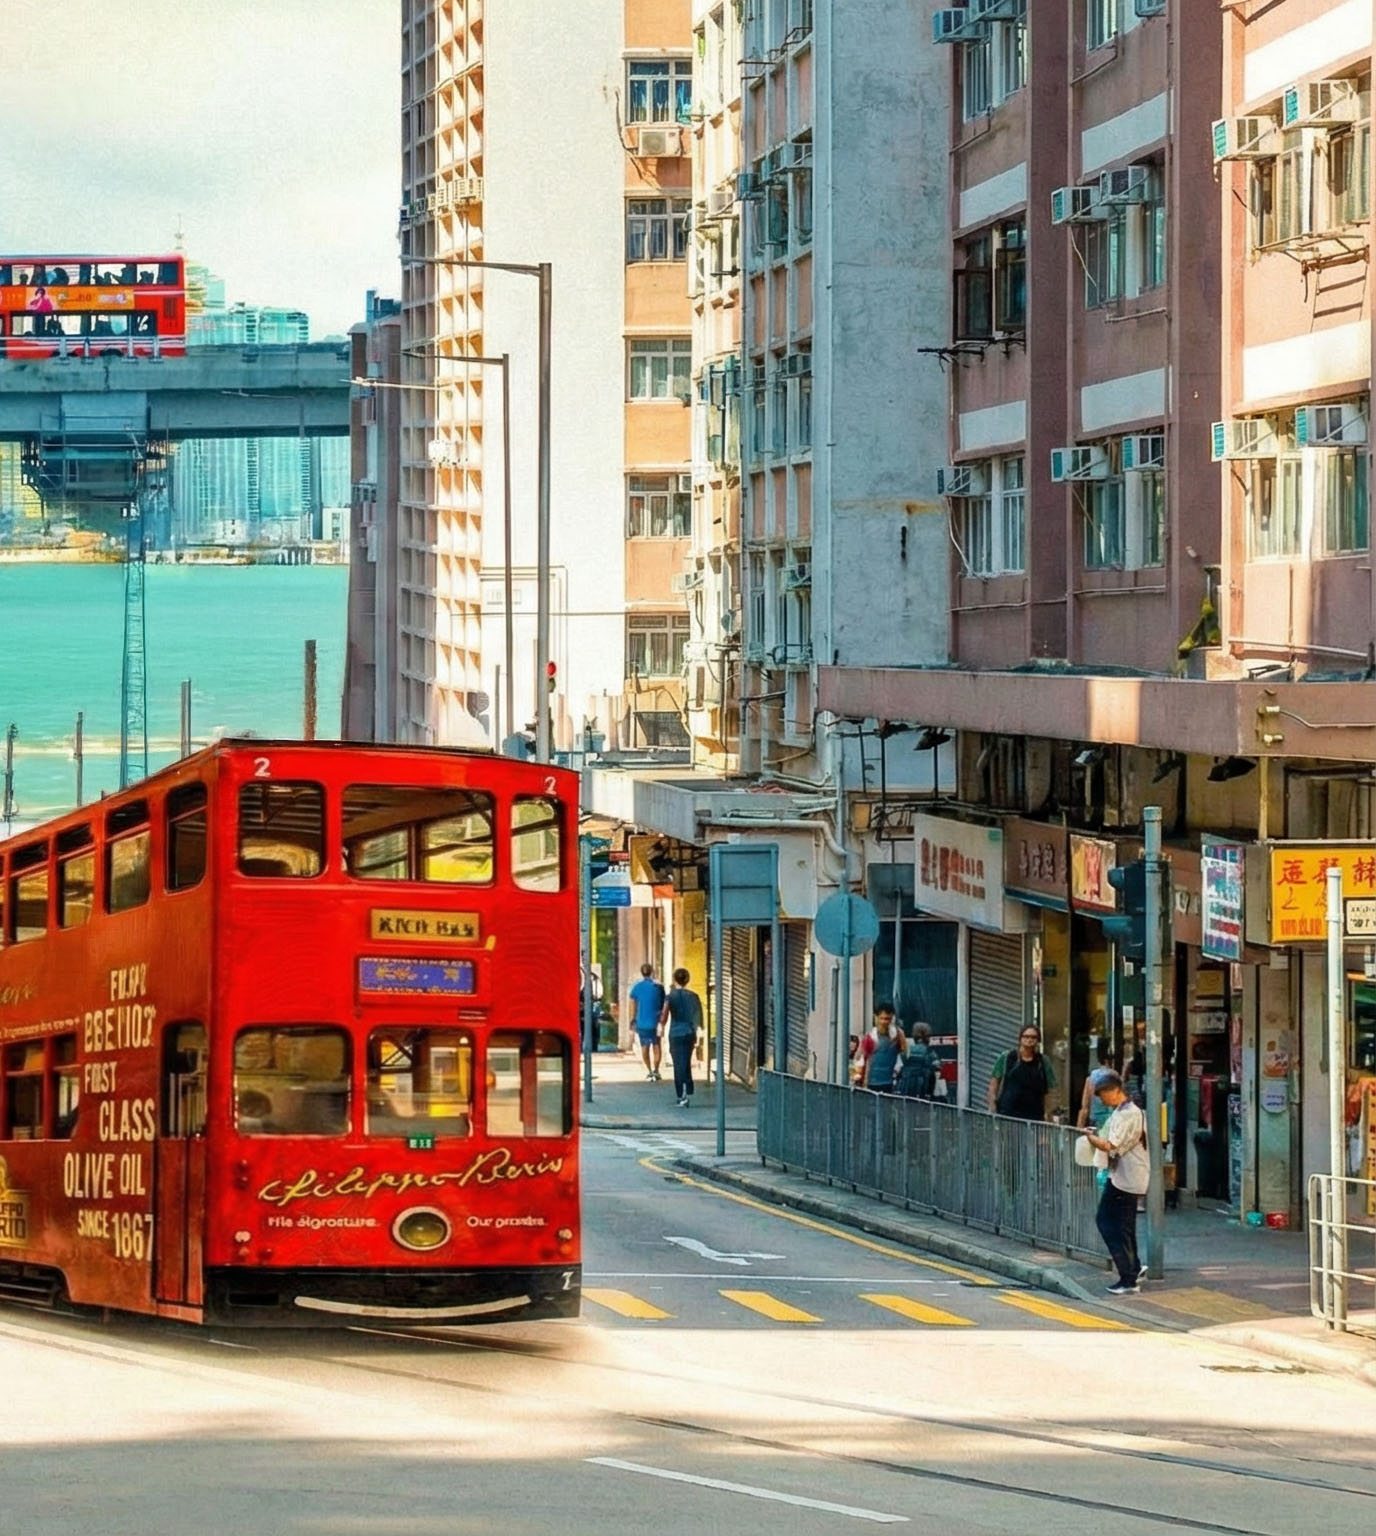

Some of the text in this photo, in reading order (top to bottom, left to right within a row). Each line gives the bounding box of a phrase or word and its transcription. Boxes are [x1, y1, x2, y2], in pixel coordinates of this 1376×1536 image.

[254, 757, 271, 777] 2
[544, 776, 557, 795] 2
[99, 1098, 155, 1141] CLASS
[64, 1152, 146, 1199] OLIVE OIL
[111, 1211, 154, 1262] 1867
